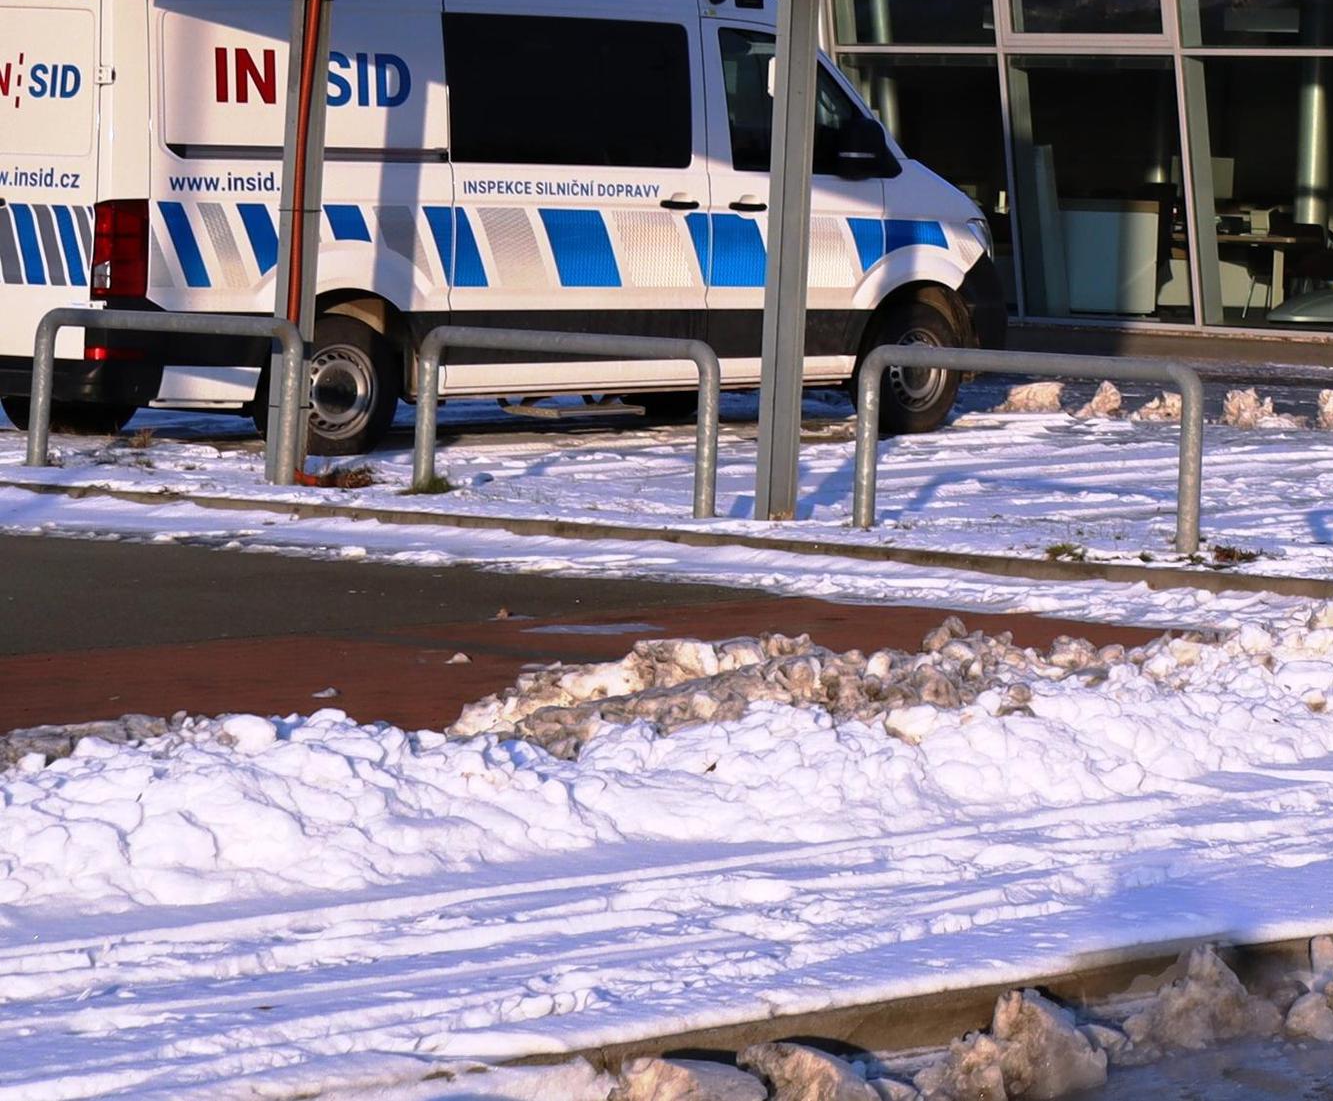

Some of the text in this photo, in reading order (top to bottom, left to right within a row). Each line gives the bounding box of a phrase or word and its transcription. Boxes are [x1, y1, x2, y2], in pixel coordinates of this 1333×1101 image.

[463, 180, 660, 198] INSPEKCE SILNIČNÍ DOPRAVY
